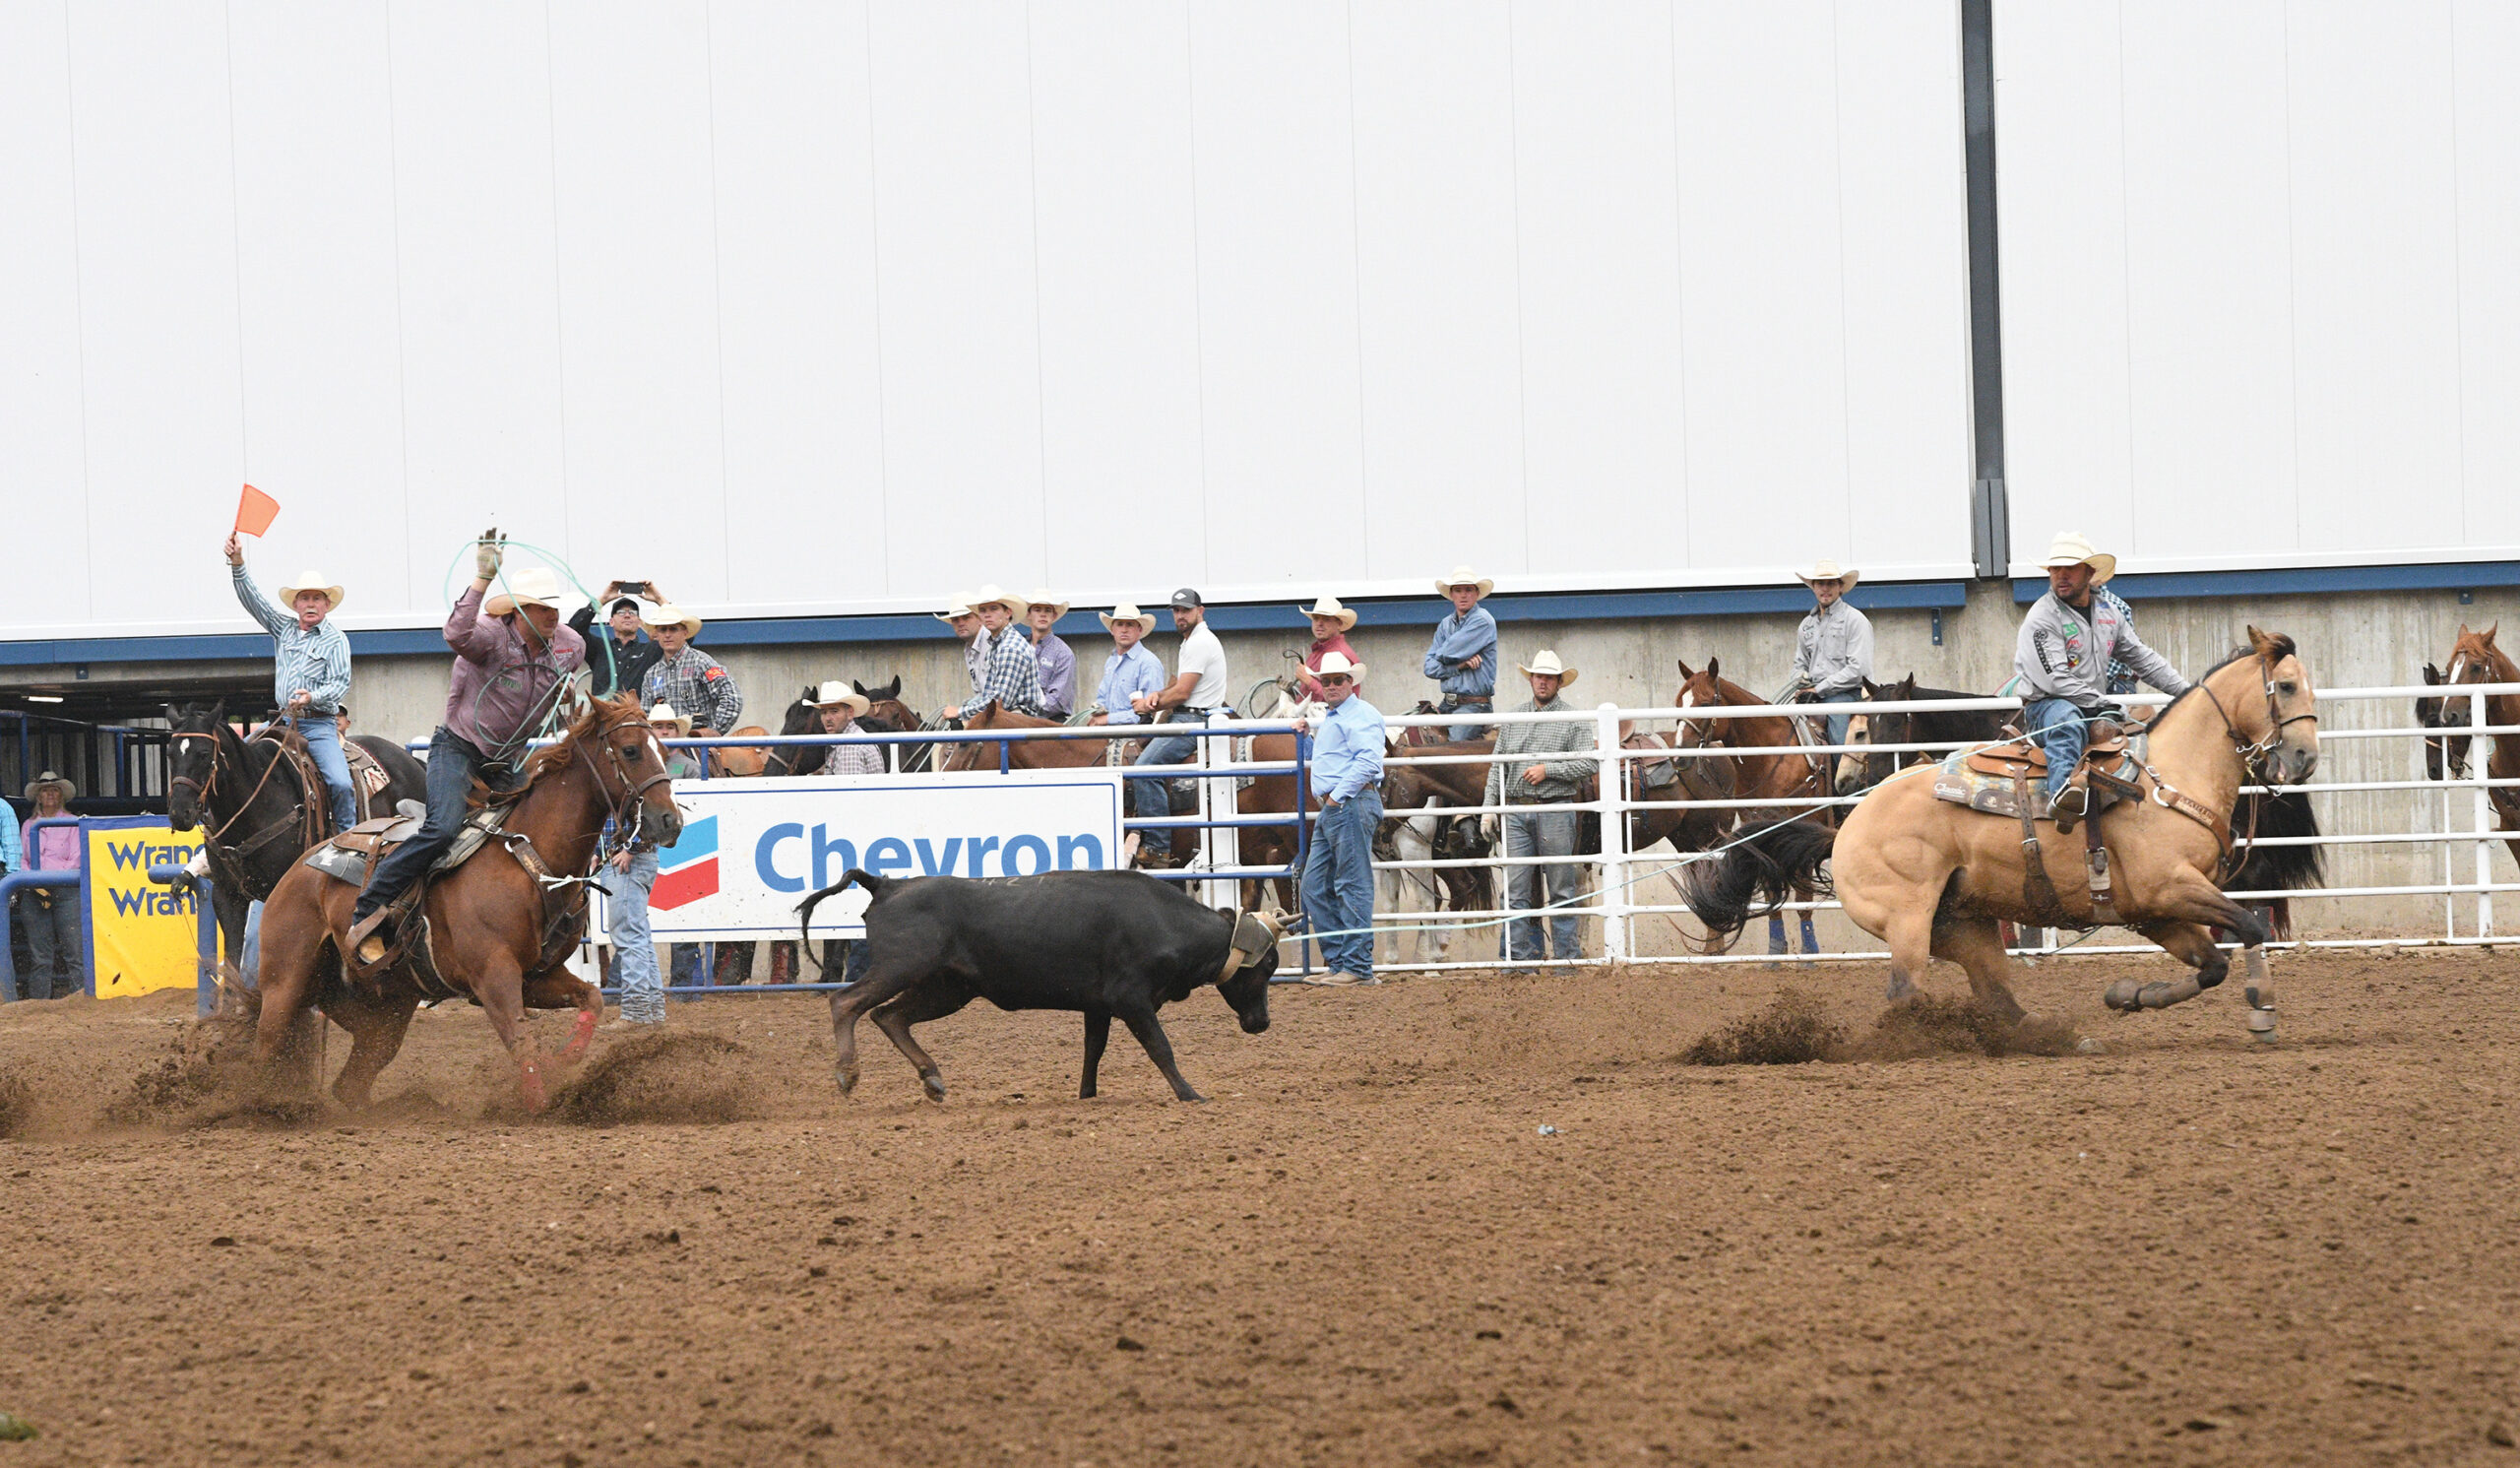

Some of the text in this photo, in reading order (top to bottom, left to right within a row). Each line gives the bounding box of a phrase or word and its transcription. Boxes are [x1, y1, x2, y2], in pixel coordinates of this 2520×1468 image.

[106, 841, 205, 871] Wran
[754, 822, 1104, 893] Chevron
[108, 887, 198, 918] Wran
